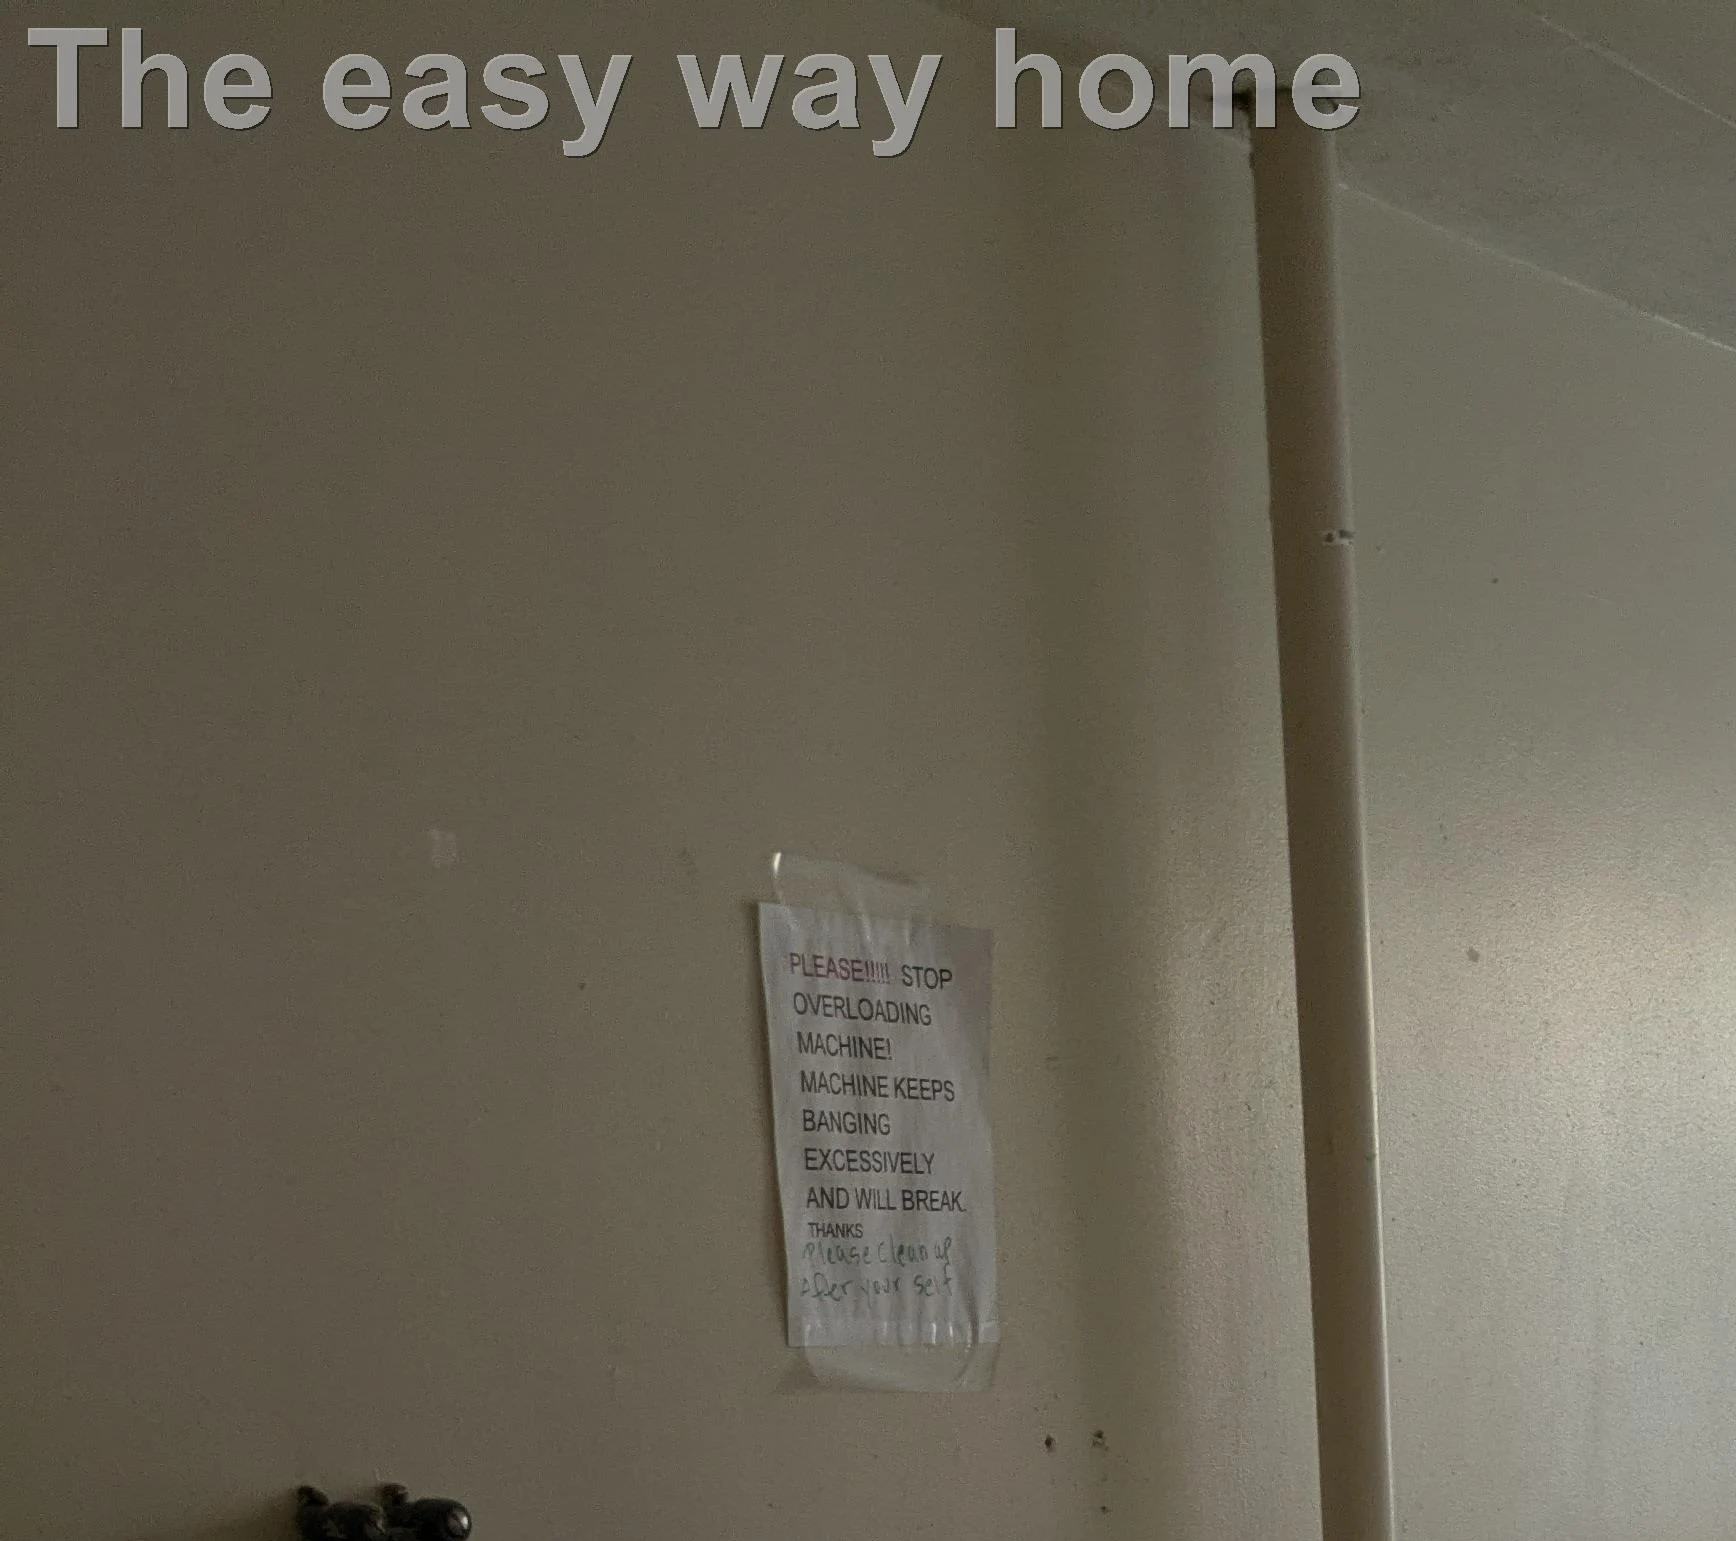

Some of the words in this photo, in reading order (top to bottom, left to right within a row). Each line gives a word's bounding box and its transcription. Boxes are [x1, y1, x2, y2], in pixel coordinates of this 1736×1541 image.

[901, 964, 954, 990] STOP
[793, 992, 933, 1026] OVERLOADING
[797, 1031, 893, 1061] MACHINE!
[801, 1069, 889, 1099] MACHINE
[894, 1076, 956, 1102] KEEPS
[802, 1109, 892, 1136] BANGING
[804, 1147, 936, 1175] EXCESSIVELY
[807, 1186, 851, 1211] AND
[854, 1188, 897, 1212] WILL
[901, 1189, 967, 1213] BREAK.
[808, 1221, 865, 1240] THANKS
